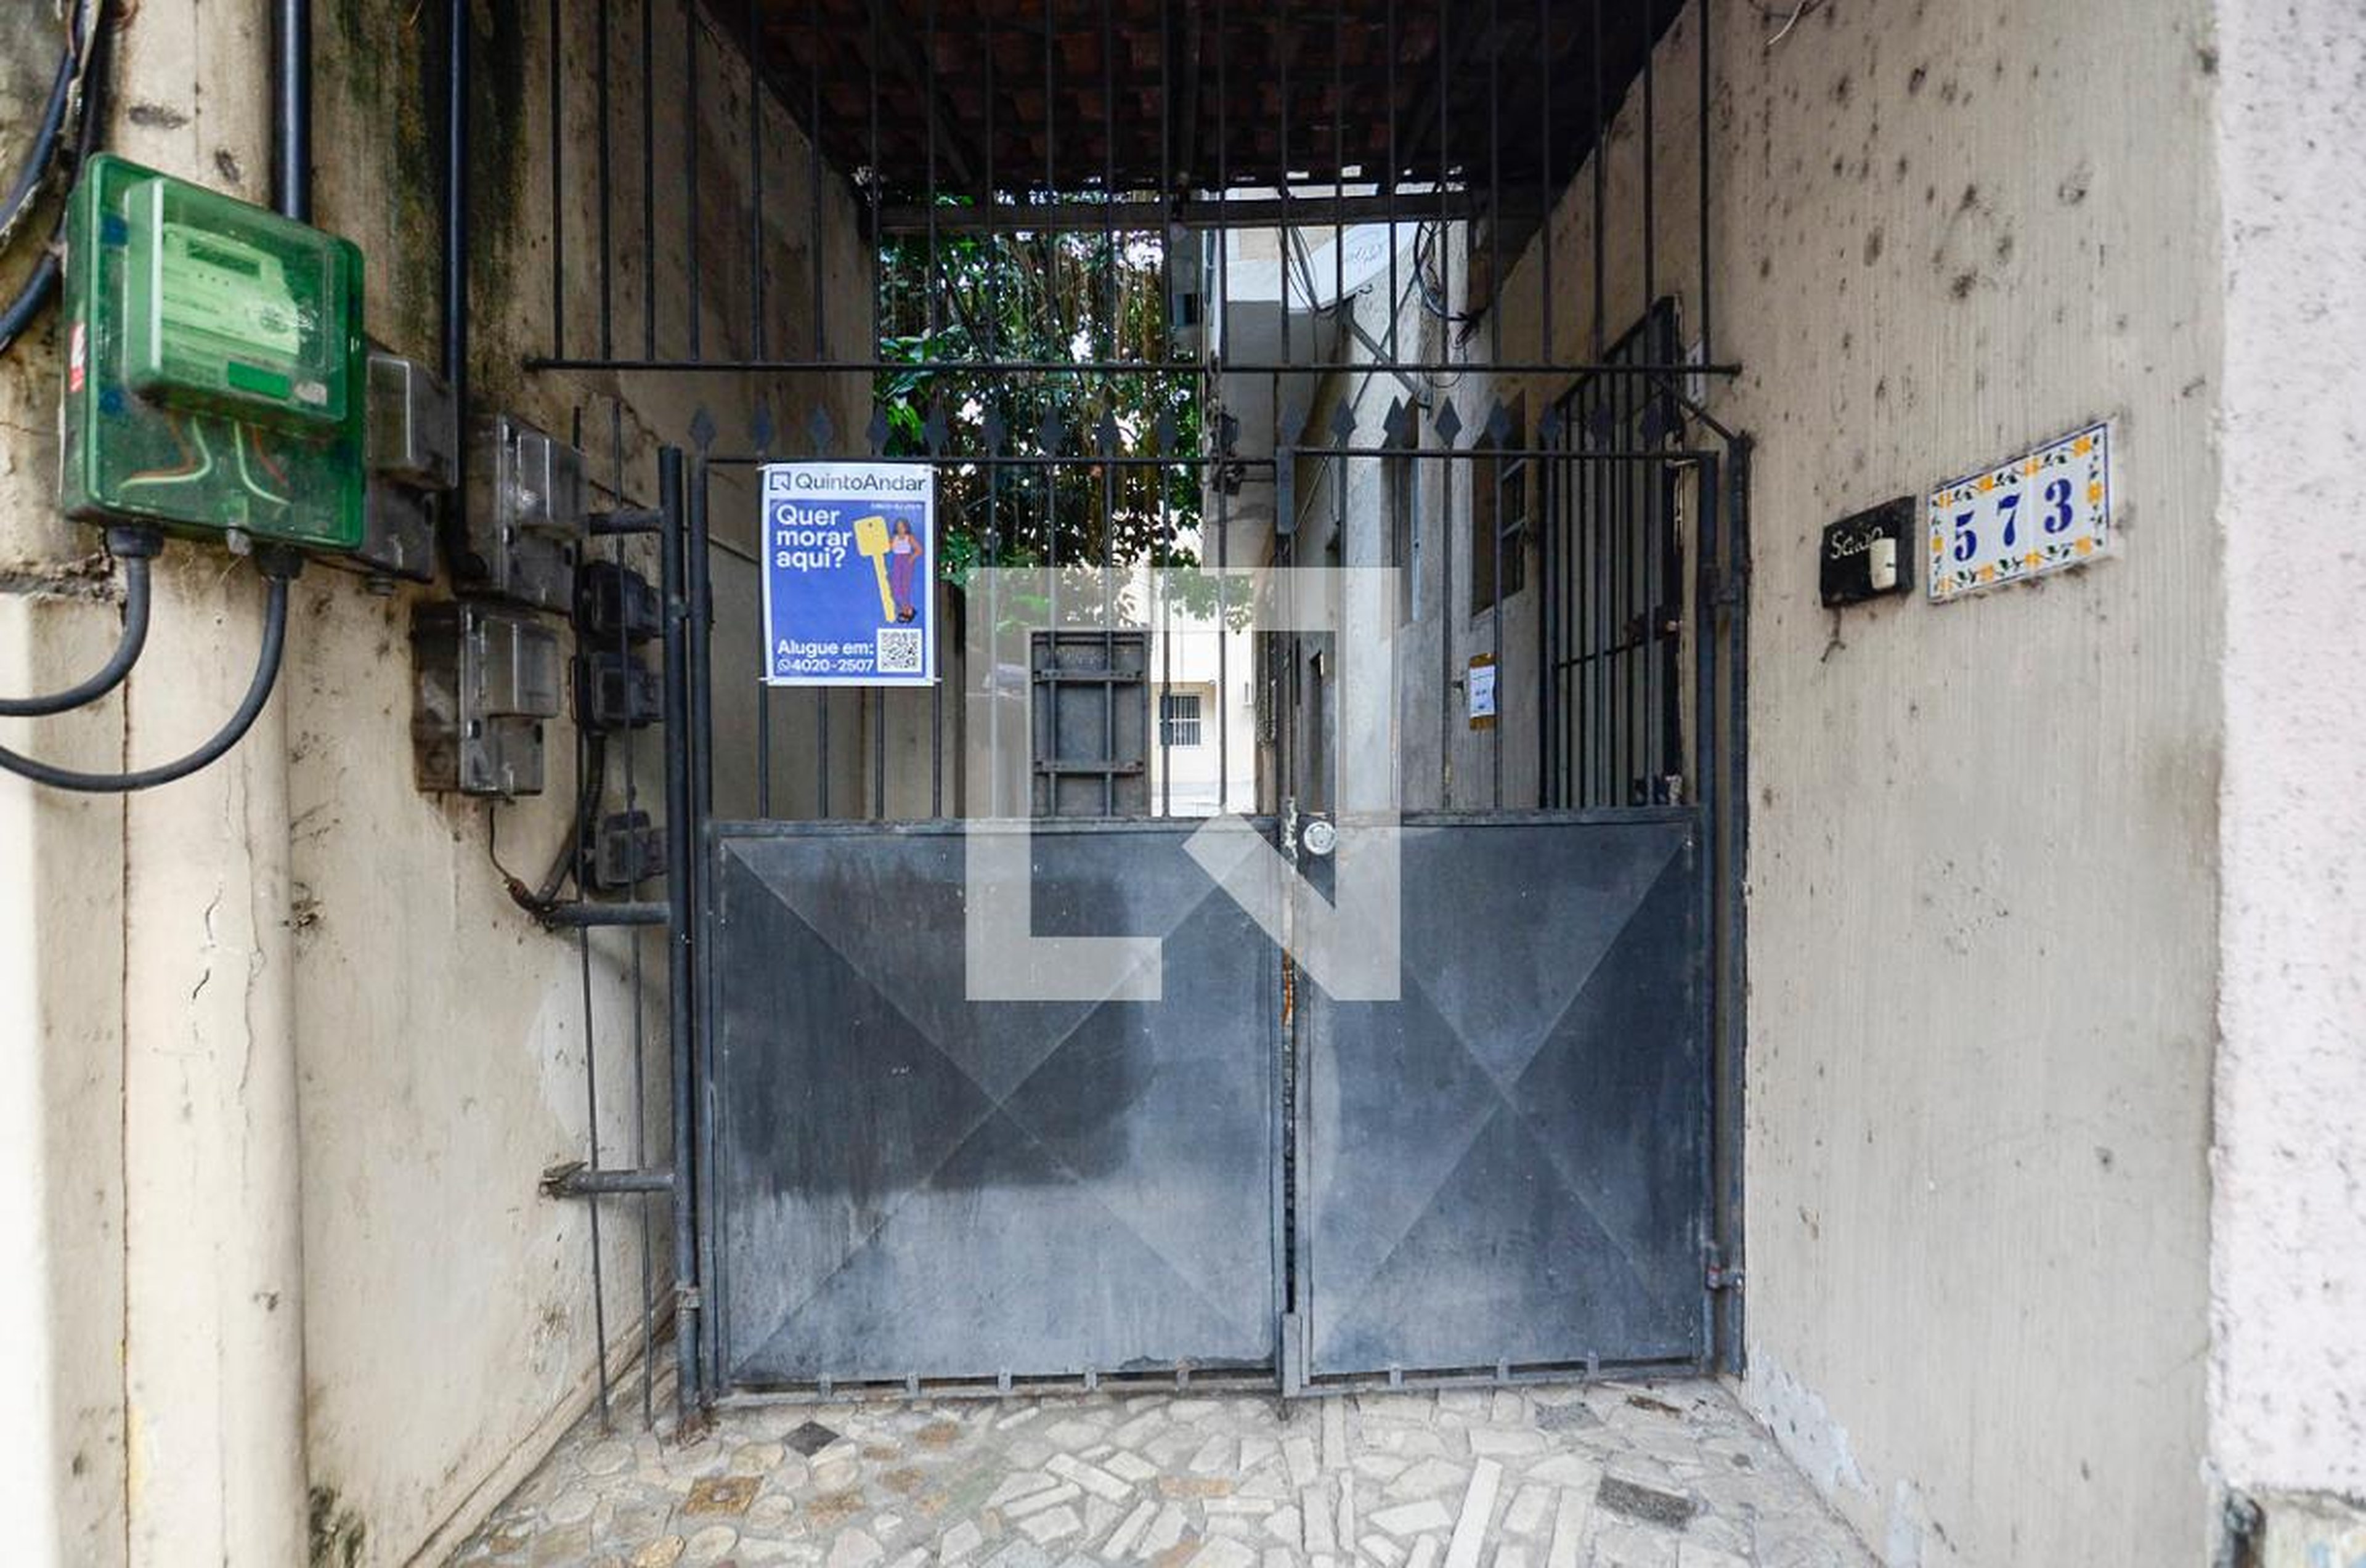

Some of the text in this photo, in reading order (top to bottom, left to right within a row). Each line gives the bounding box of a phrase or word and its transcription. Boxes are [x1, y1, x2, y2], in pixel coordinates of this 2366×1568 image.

[795, 473, 925, 491] QuintoAndar
[776, 504, 840, 526] Quer
[1953, 478, 2073, 562] 573
[776, 530, 852, 547] morar
[776, 547, 846, 572] aqui?
[778, 639, 874, 658] Alugue em:
[791, 659, 874, 672] 4020-2507
